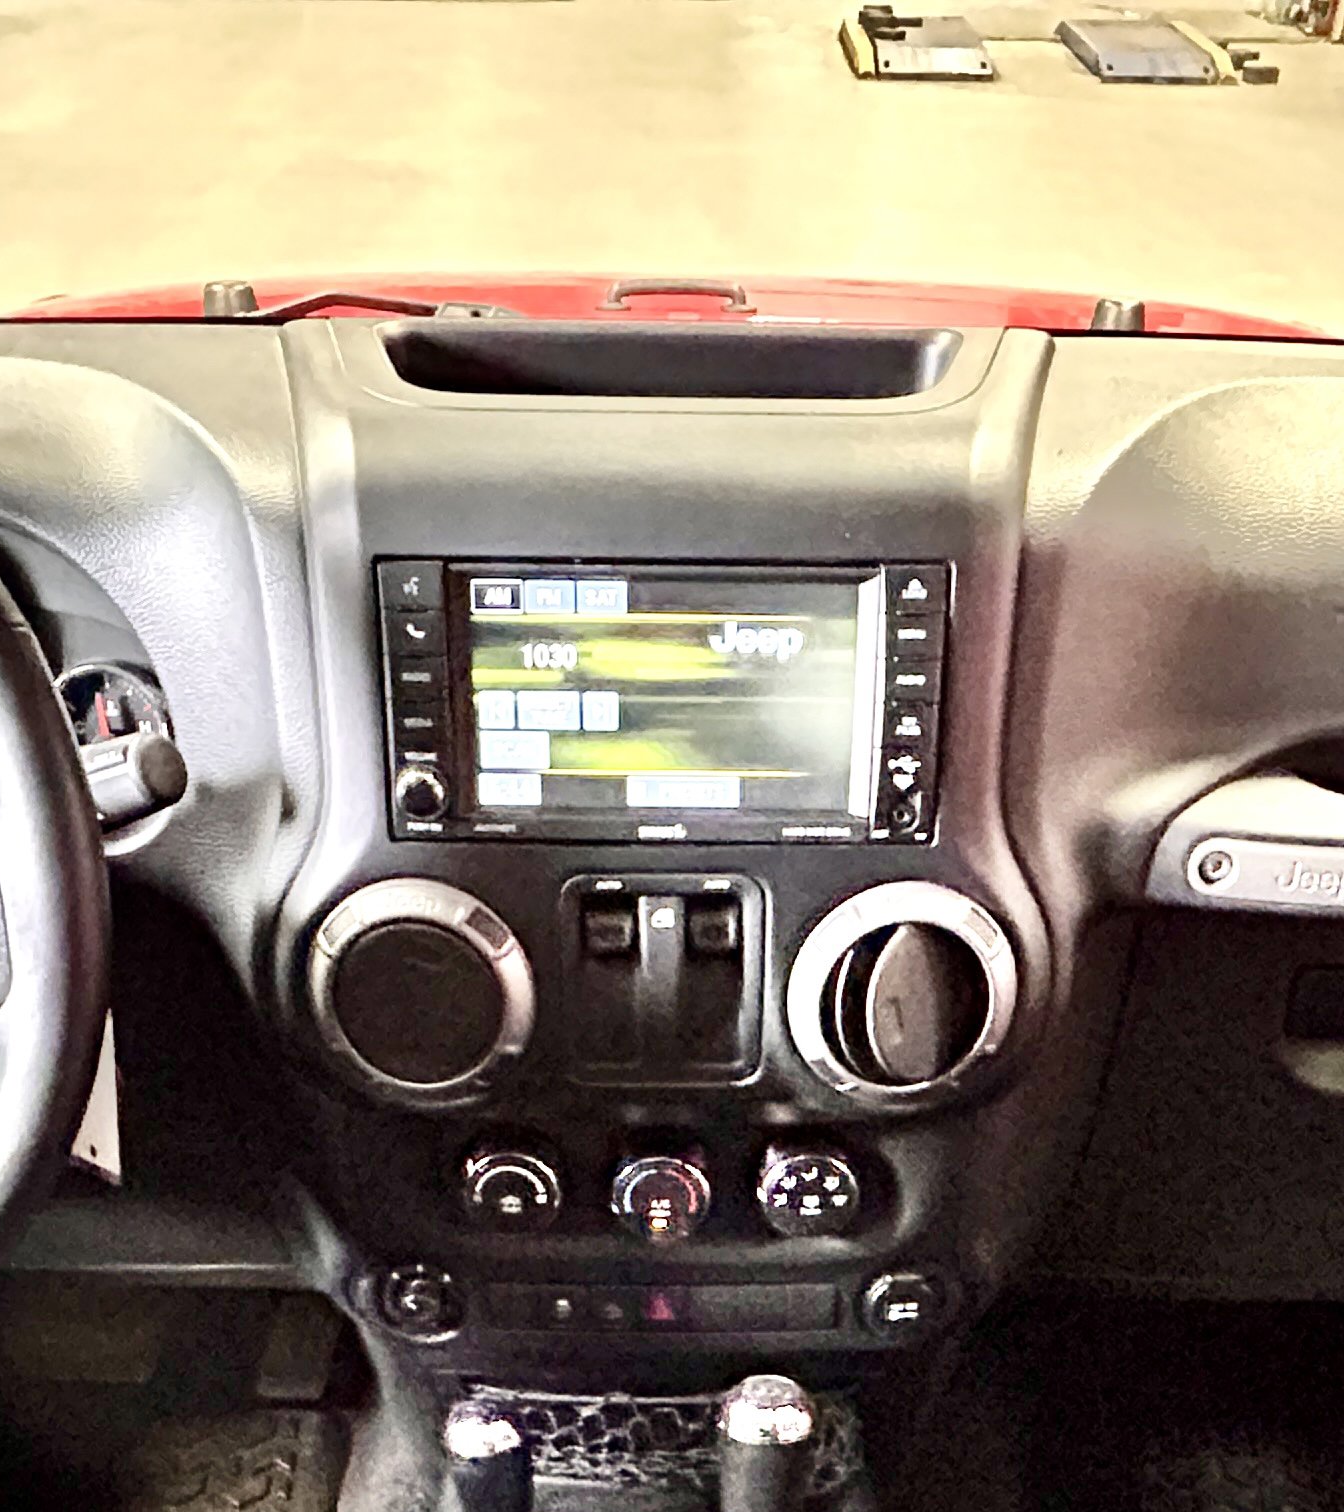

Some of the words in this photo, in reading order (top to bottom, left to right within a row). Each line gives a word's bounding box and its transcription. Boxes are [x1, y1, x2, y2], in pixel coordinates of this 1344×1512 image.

[483, 587, 513, 606] AM
[708, 620, 804, 664] Jeep
[521, 643, 578, 670] 1030
